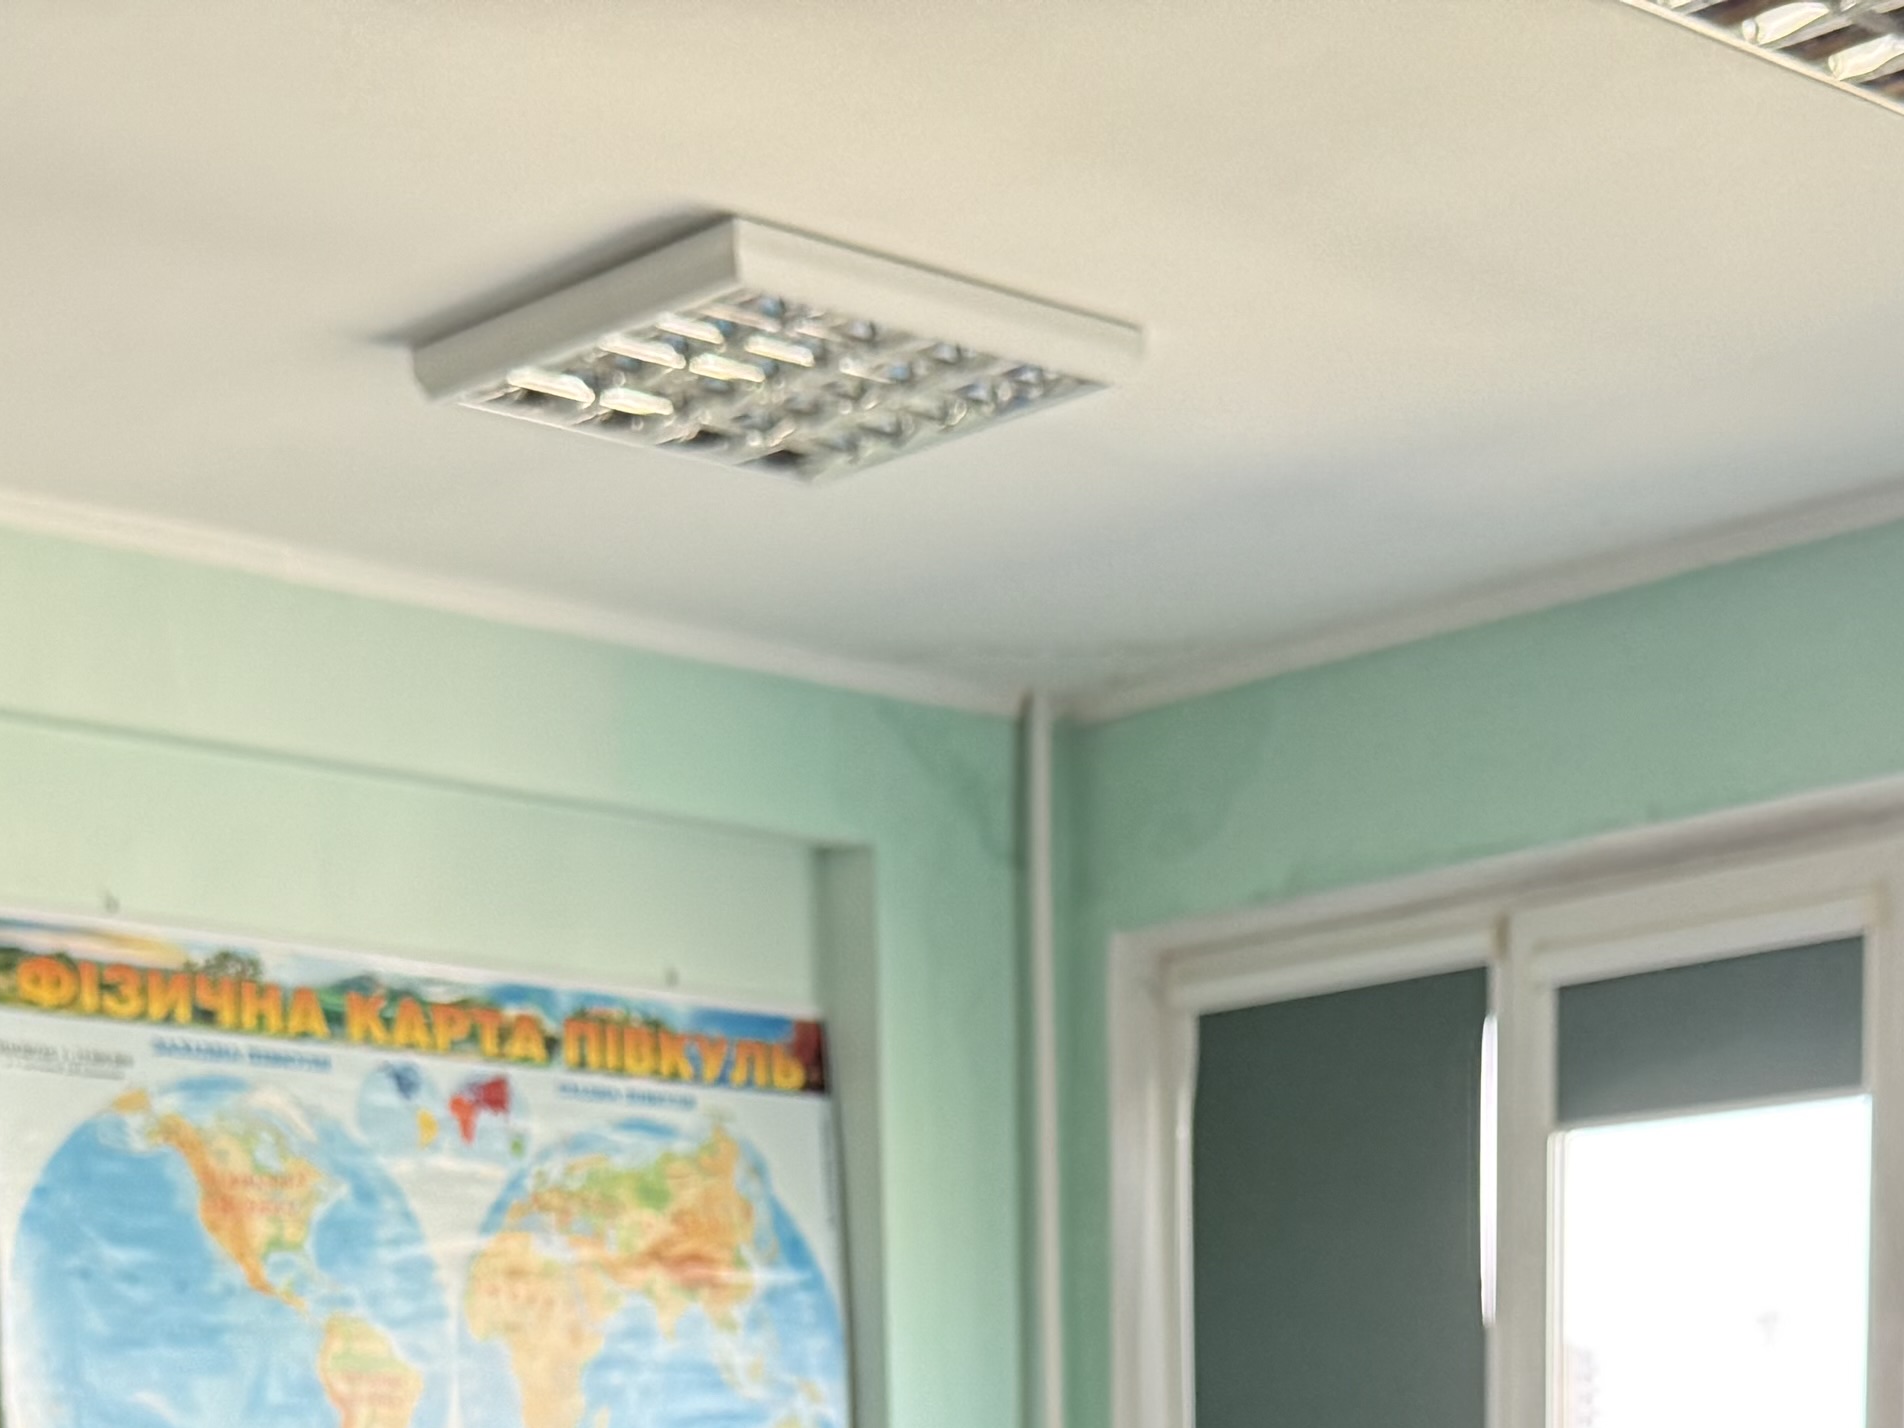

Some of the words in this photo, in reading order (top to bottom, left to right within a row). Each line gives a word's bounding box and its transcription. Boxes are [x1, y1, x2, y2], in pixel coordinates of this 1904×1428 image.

[16, 956, 331, 1041] ФІЗИЧНА
[345, 989, 549, 1064] КАРТА
[563, 1016, 806, 1091] ПІВКУЛЬ
